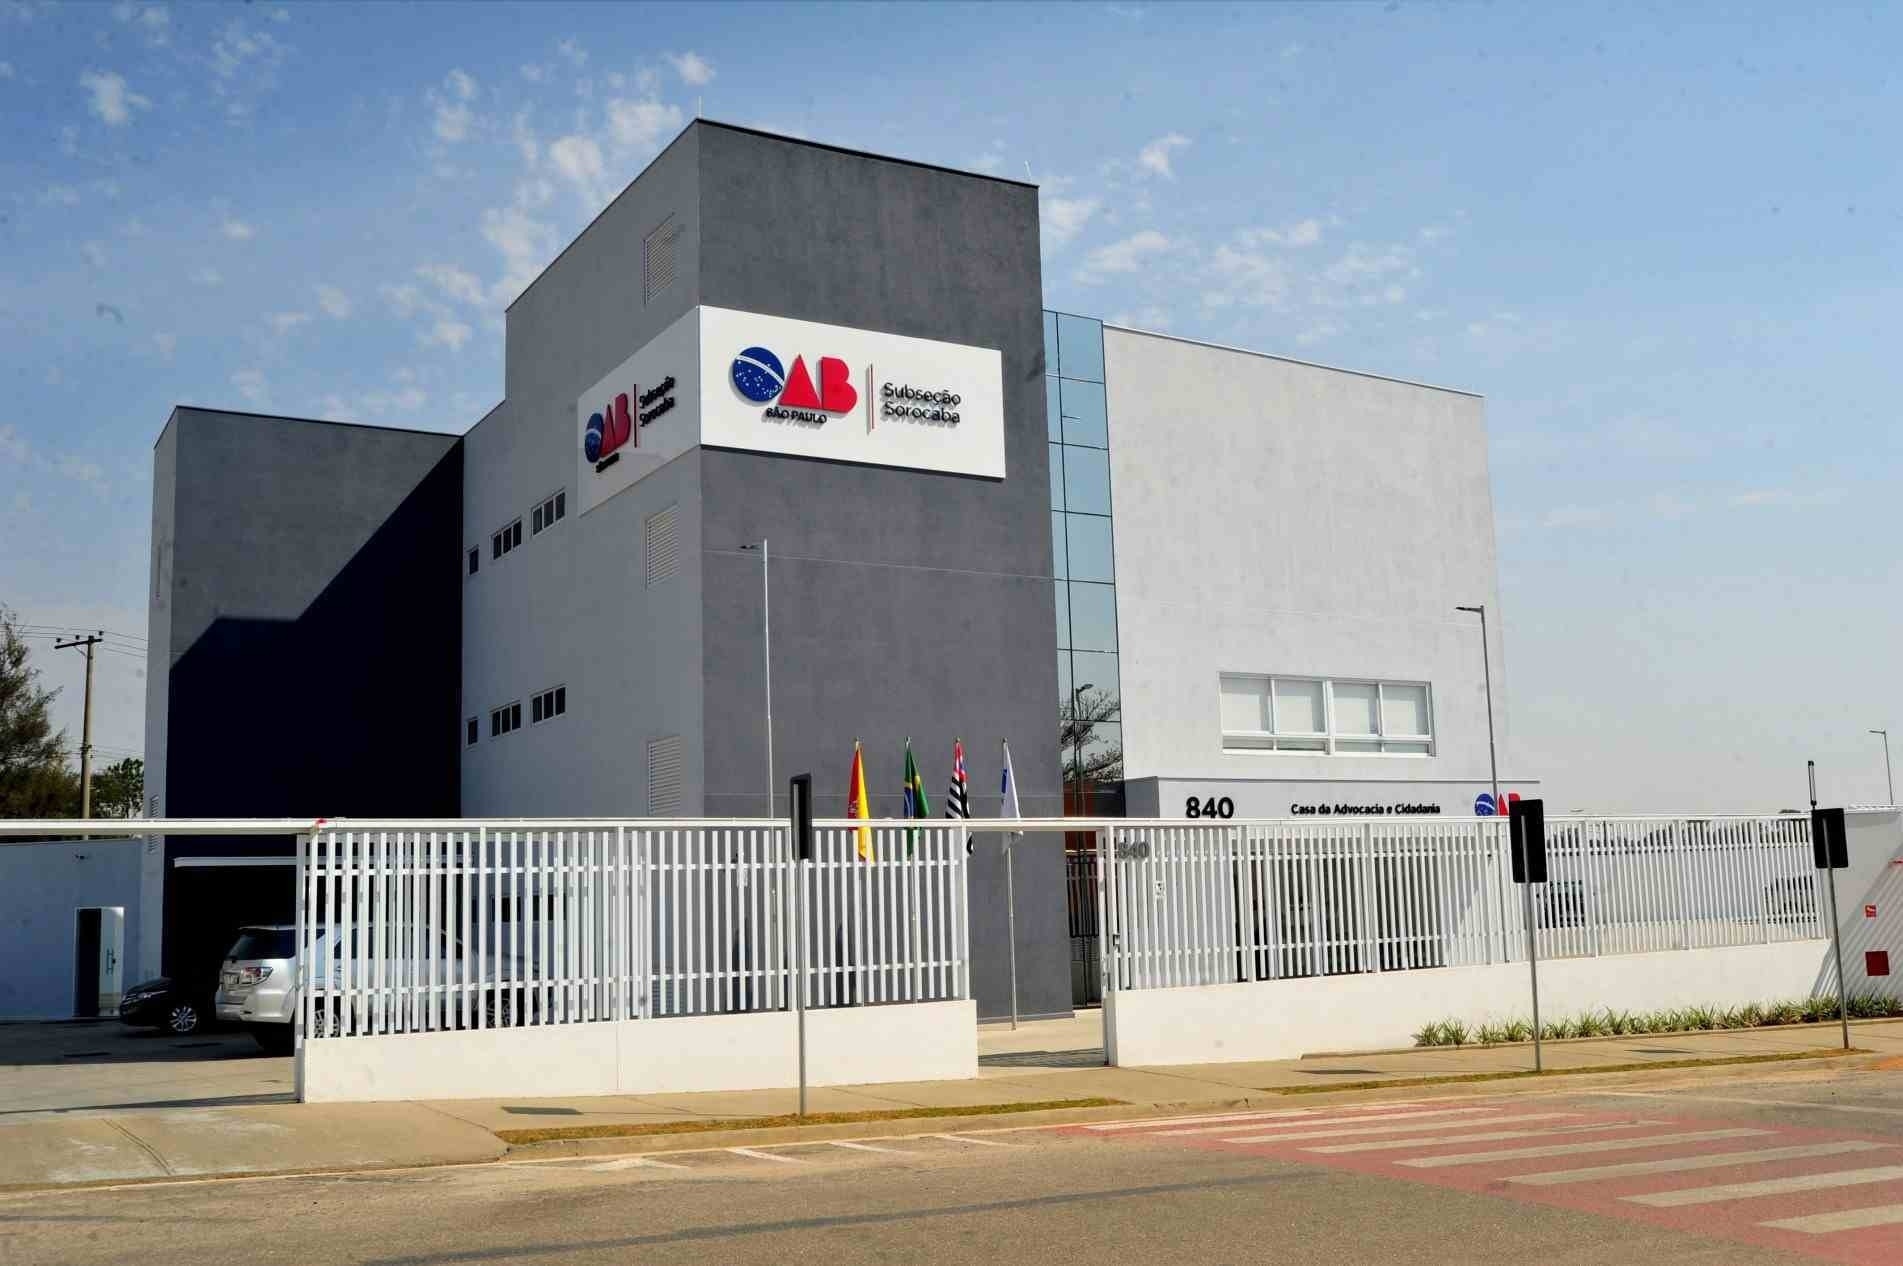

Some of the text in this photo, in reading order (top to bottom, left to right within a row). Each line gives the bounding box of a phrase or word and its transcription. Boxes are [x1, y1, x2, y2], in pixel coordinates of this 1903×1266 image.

[732, 346, 858, 414] OAB
[884, 382, 961, 405] Subseção
[791, 410, 828, 424] PAULO
[884, 401, 961, 423] Sorocaba
[584, 393, 631, 464] OAB
[1185, 796, 1235, 819] 840
[1291, 803, 1441, 815] Casa da Advocacia e Cidadania
[1474, 793, 1521, 817] OA
